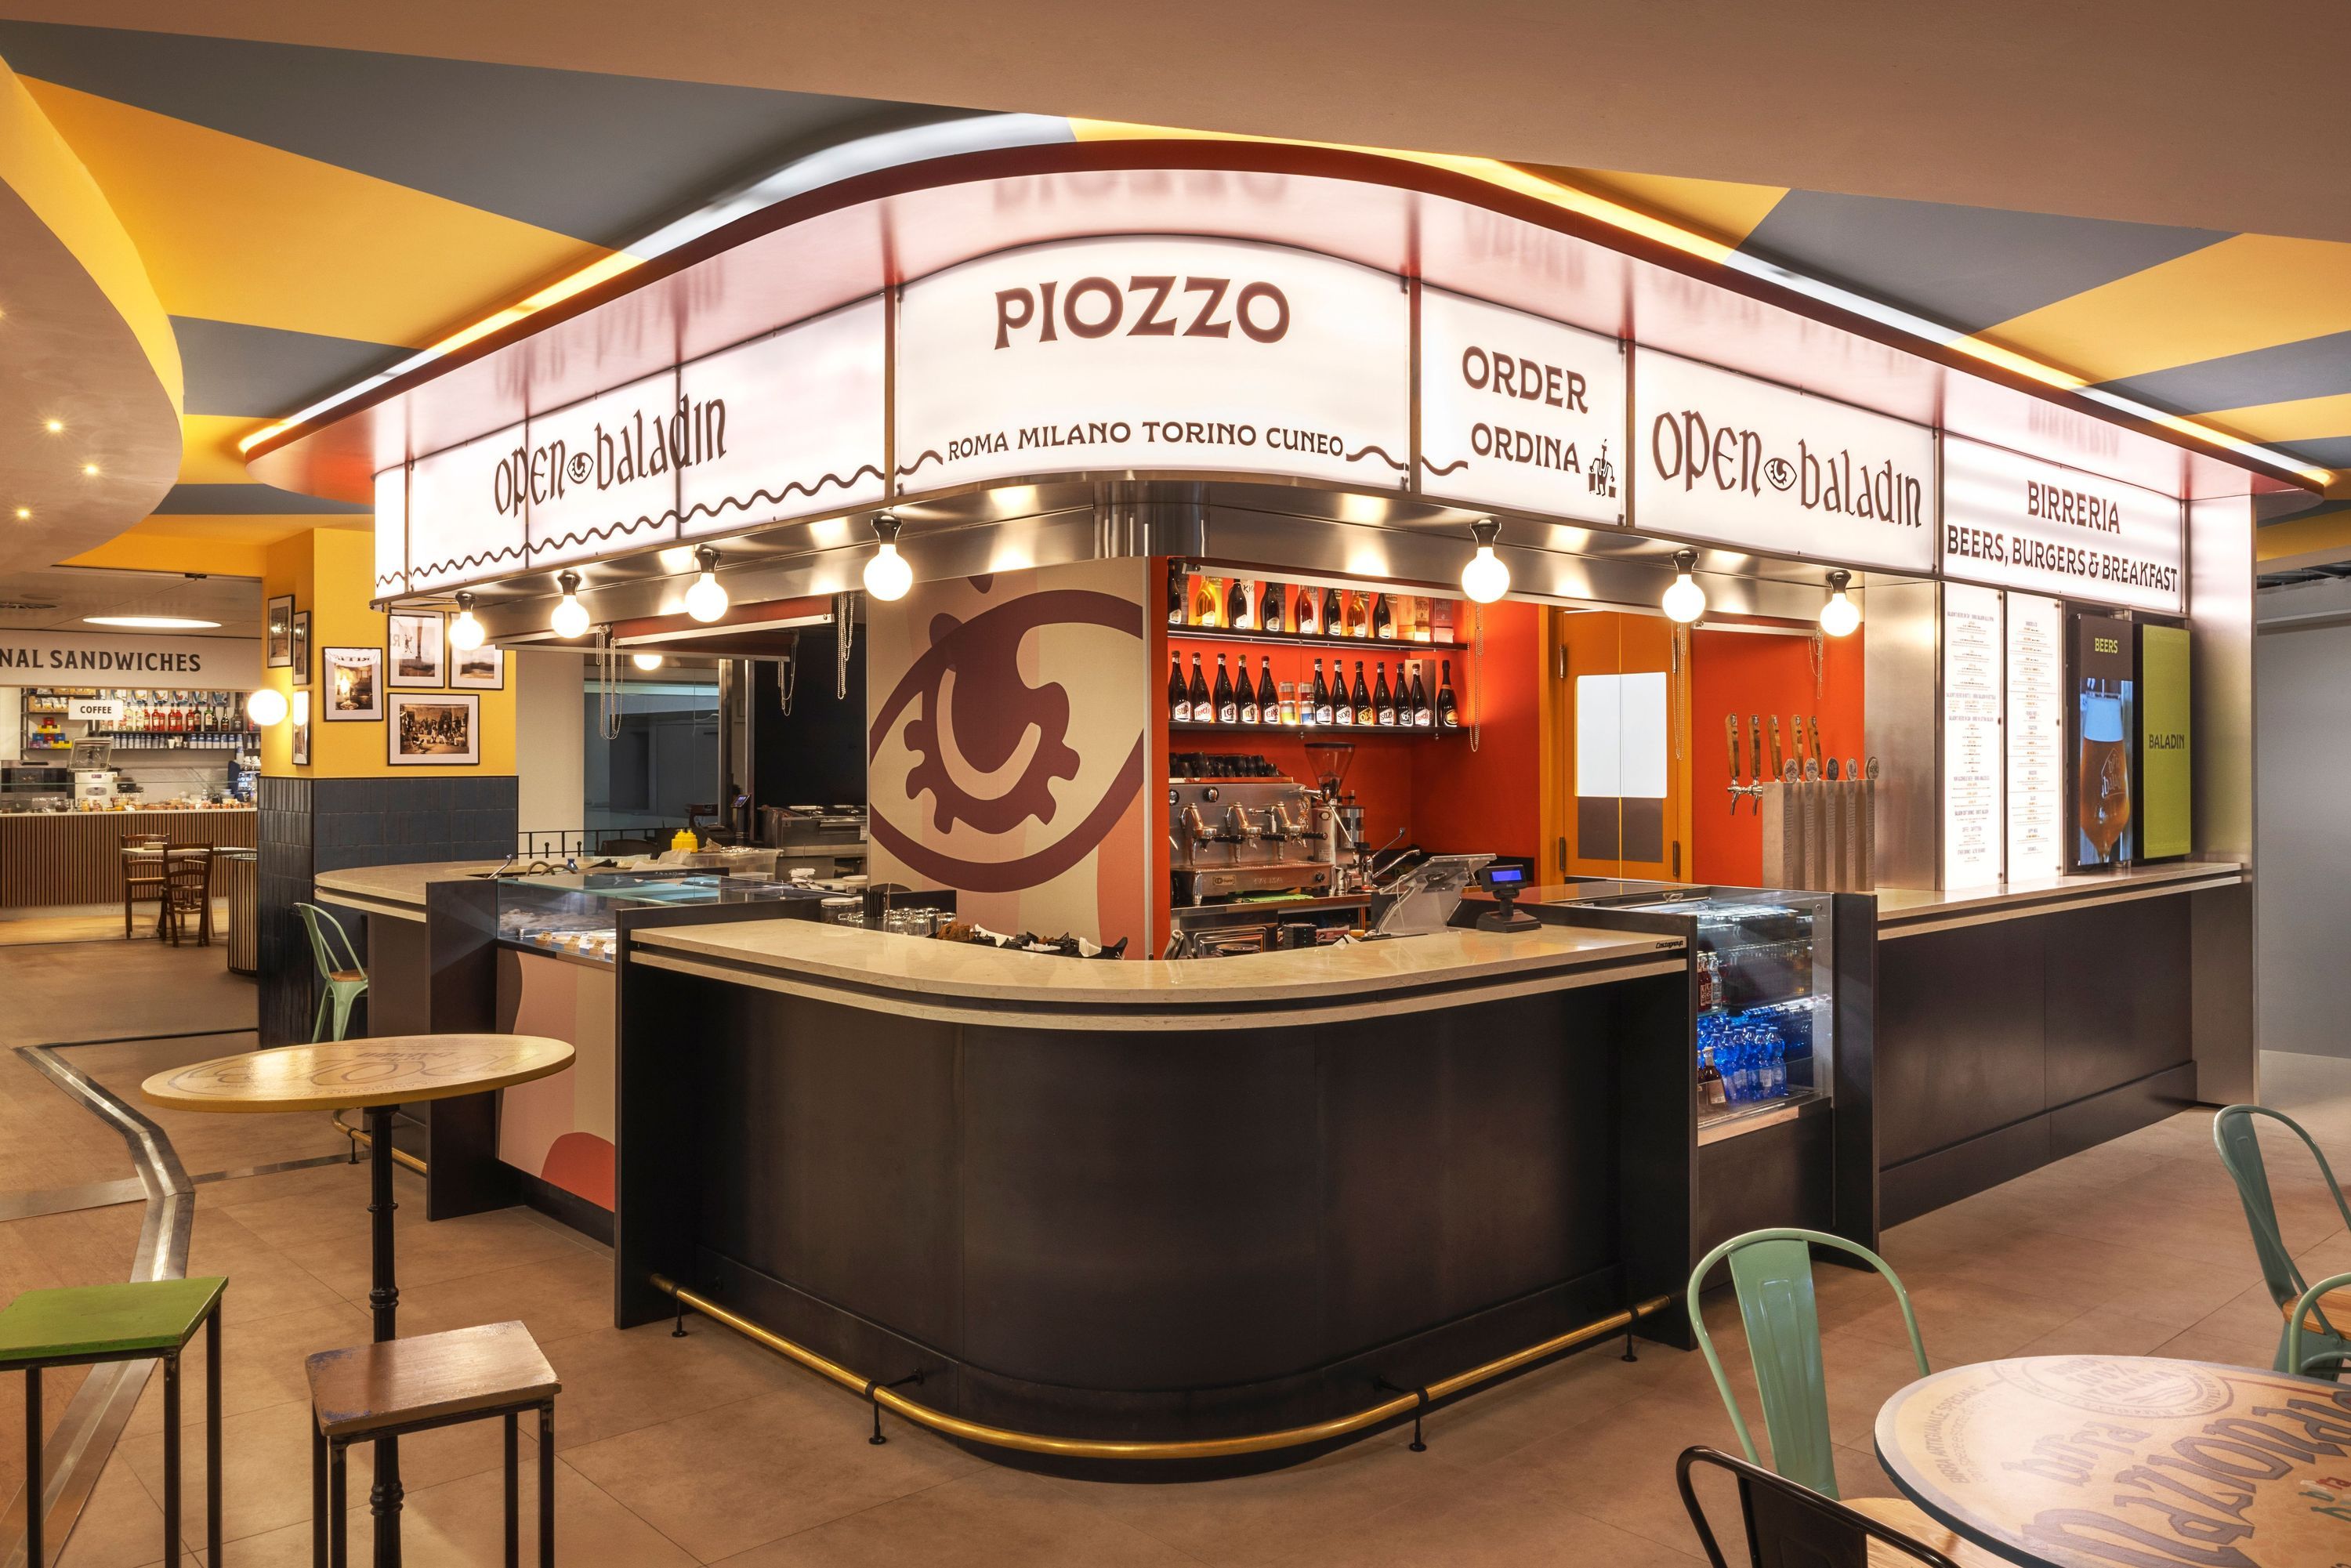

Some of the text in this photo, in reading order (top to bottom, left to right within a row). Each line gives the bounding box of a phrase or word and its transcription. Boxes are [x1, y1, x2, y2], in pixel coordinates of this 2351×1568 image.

[994, 275, 1291, 350] PIOZZO
[1462, 346, 1589, 415] ORDER
[594, 393, 727, 491] baladin
[948, 421, 1344, 462] ROMA MILANO TORINO CUNEO
[1471, 422, 1581, 474] ORDINA
[1798, 438, 1922, 529] baladin
[2027, 480, 2121, 534] BIRRERIA
[1947, 523, 2178, 592] BEERS, BURGERS & BREAKFAST
[0, 648, 201, 672] NAL SANDWICHES
[2094, 637, 2119, 654] BEERS
[80, 705, 112, 715] COFFEE
[2148, 733, 2185, 750] BALADIN
[2065, 1364, 2139, 1386] 100%
[1924, 1410, 1950, 1457] ARTIGIANALE
[1934, 1459, 1970, 1483] BIRRA
